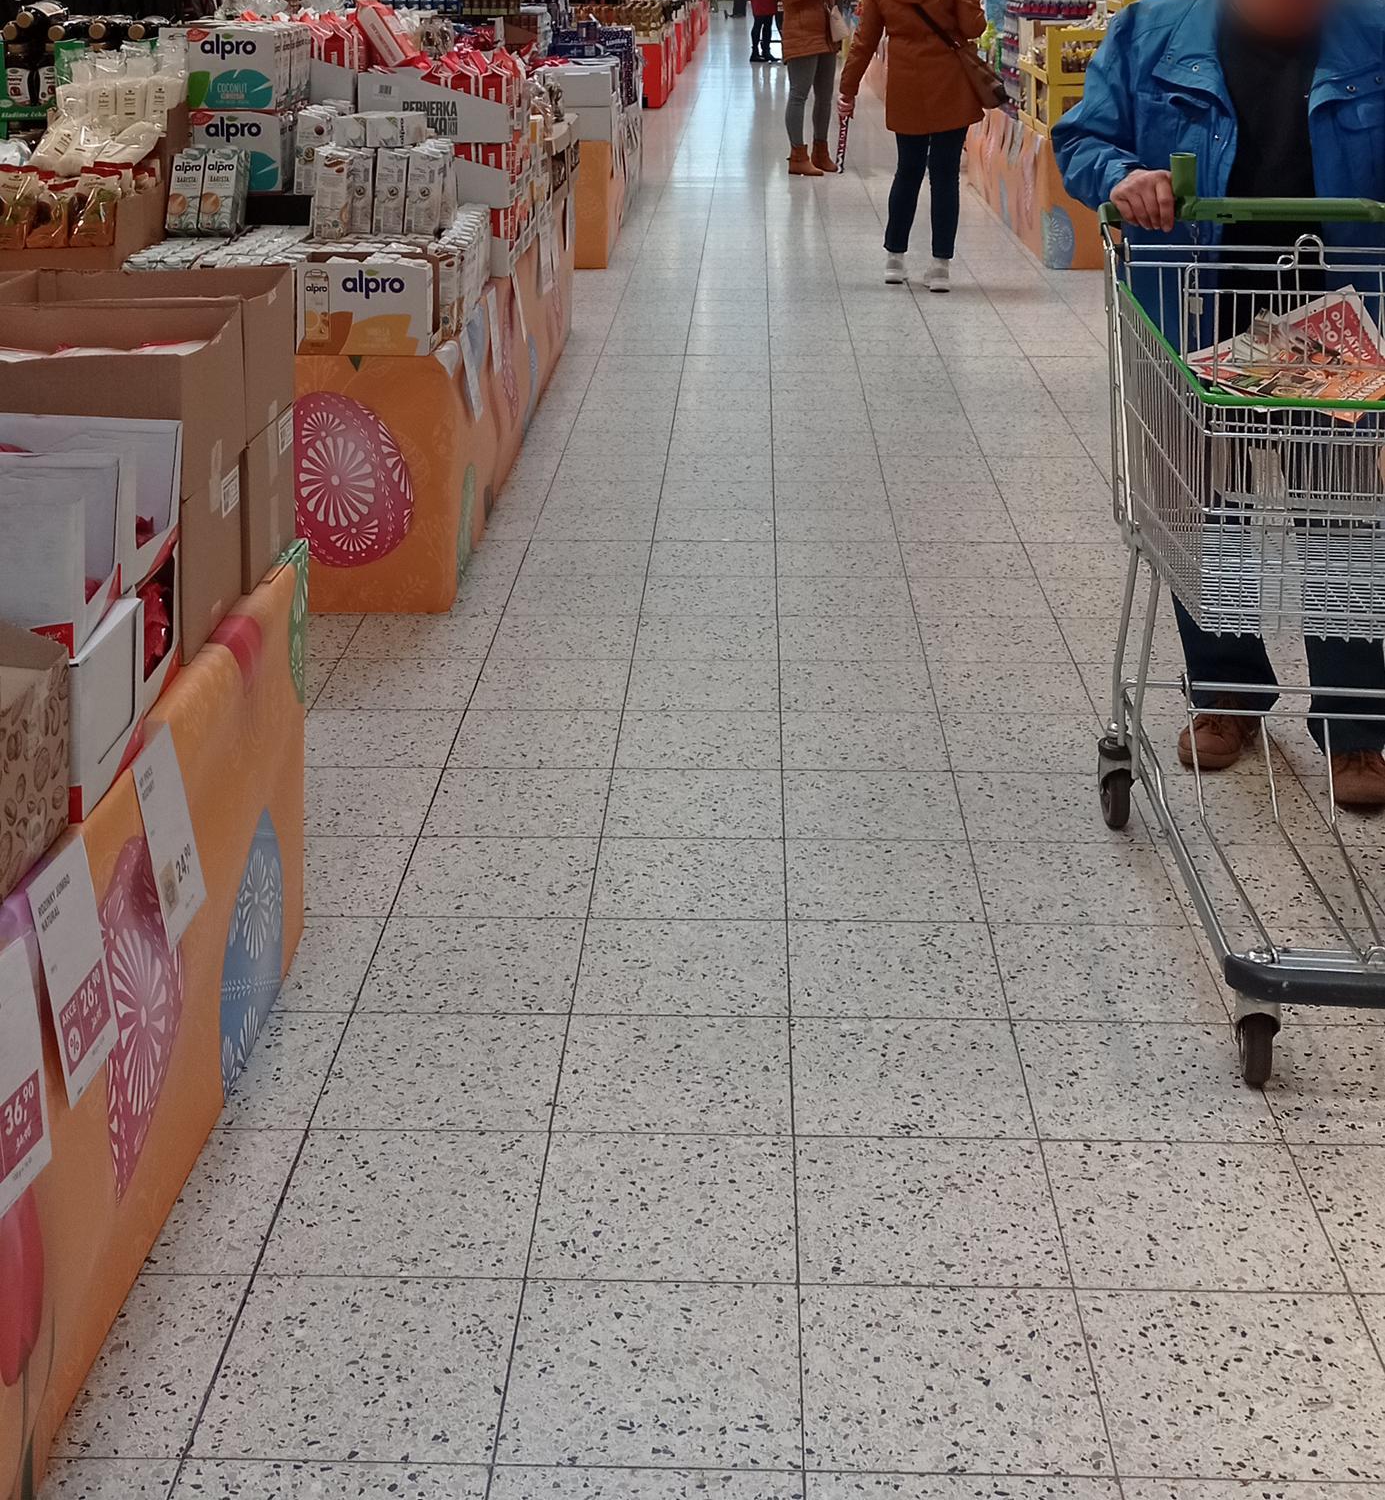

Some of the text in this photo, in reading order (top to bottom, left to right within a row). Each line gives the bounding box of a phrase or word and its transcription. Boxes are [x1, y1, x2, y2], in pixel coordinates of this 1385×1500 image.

[201, 34, 257, 60] alpro
[216, 83, 247, 93] COCONUT
[205, 116, 262, 142] alpro
[175, 161, 201, 174] alpro
[208, 161, 234, 173] alpro
[306, 283, 328, 294] alpro
[342, 269, 405, 299] alpro
[175, 843, 191, 883] 24,90
[80, 969, 101, 1017] 26,90
[61, 1000, 77, 1028] AKCE
[4, 1080, 34, 1137] 36,90
